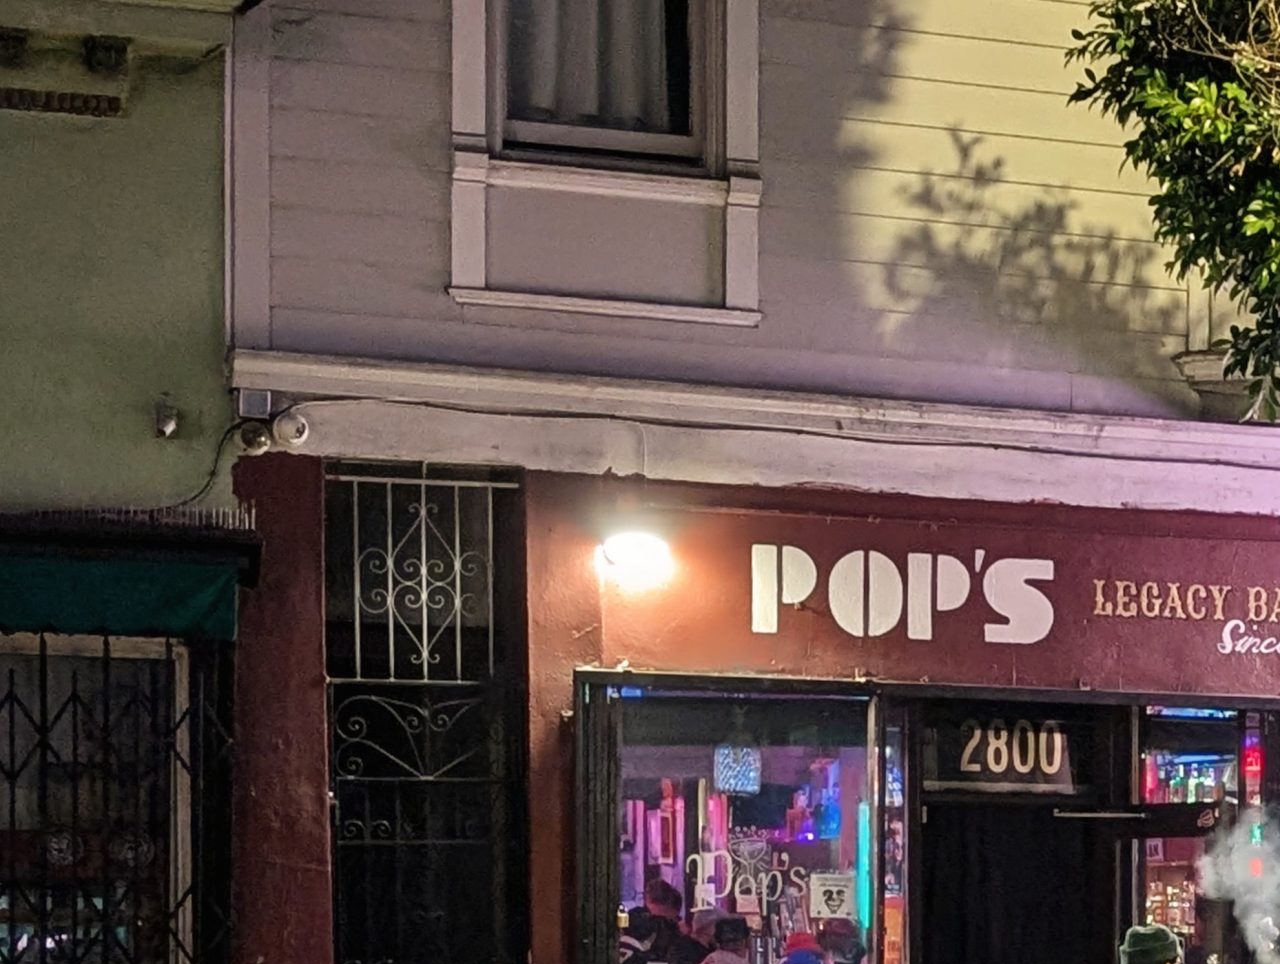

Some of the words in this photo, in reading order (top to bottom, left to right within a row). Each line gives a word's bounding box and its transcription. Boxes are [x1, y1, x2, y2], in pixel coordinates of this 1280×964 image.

[751, 543, 1054, 644] POP'S
[1093, 579, 1232, 621] LEGACY
[960, 719, 1062, 775] 2800
[686, 850, 808, 917] Pop's
